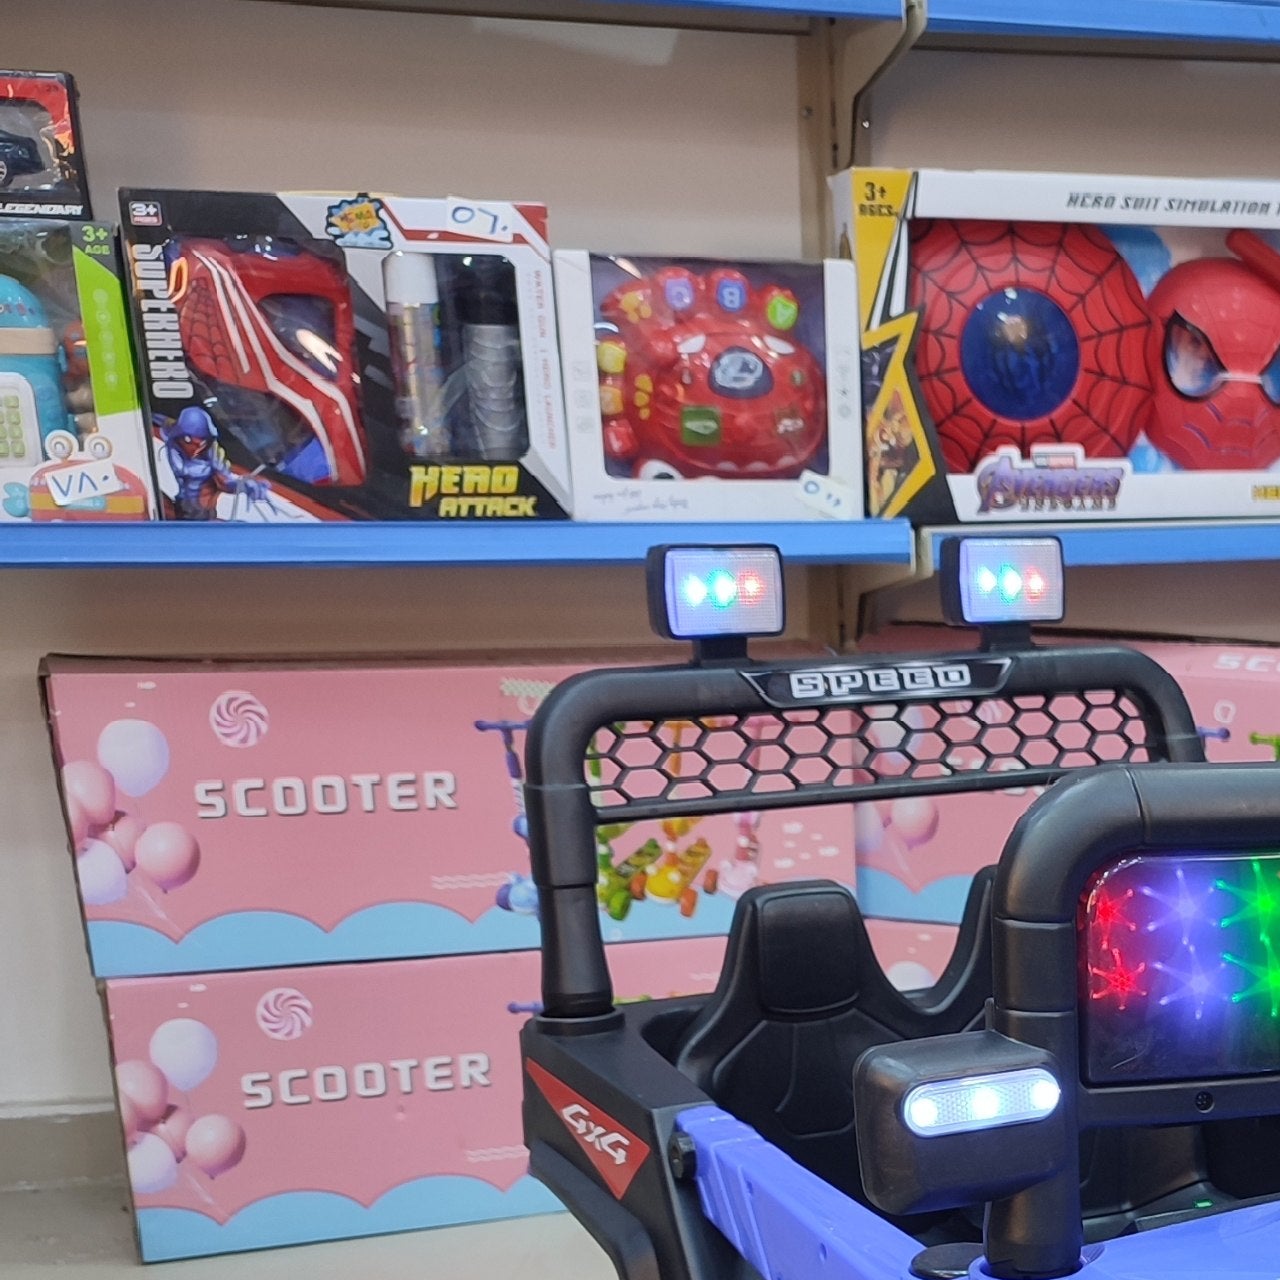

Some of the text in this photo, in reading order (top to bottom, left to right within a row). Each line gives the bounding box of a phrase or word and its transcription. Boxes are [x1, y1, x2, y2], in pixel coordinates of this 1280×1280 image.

[864, 181, 887, 201] 3+
[1066, 191, 1117, 209] HERO
[1120, 194, 1161, 212] SUIT
[131, 202, 158, 216] 3+
[81, 225, 109, 243] 3+
[130, 243, 194, 399] SUPERHERO
[408, 464, 519, 507] HERO
[437, 495, 539, 518] ATTACK
[788, 662, 972, 700] SPEED
[194, 770, 458, 820] SCOOTER
[241, 1051, 493, 1110] SCOOTER
